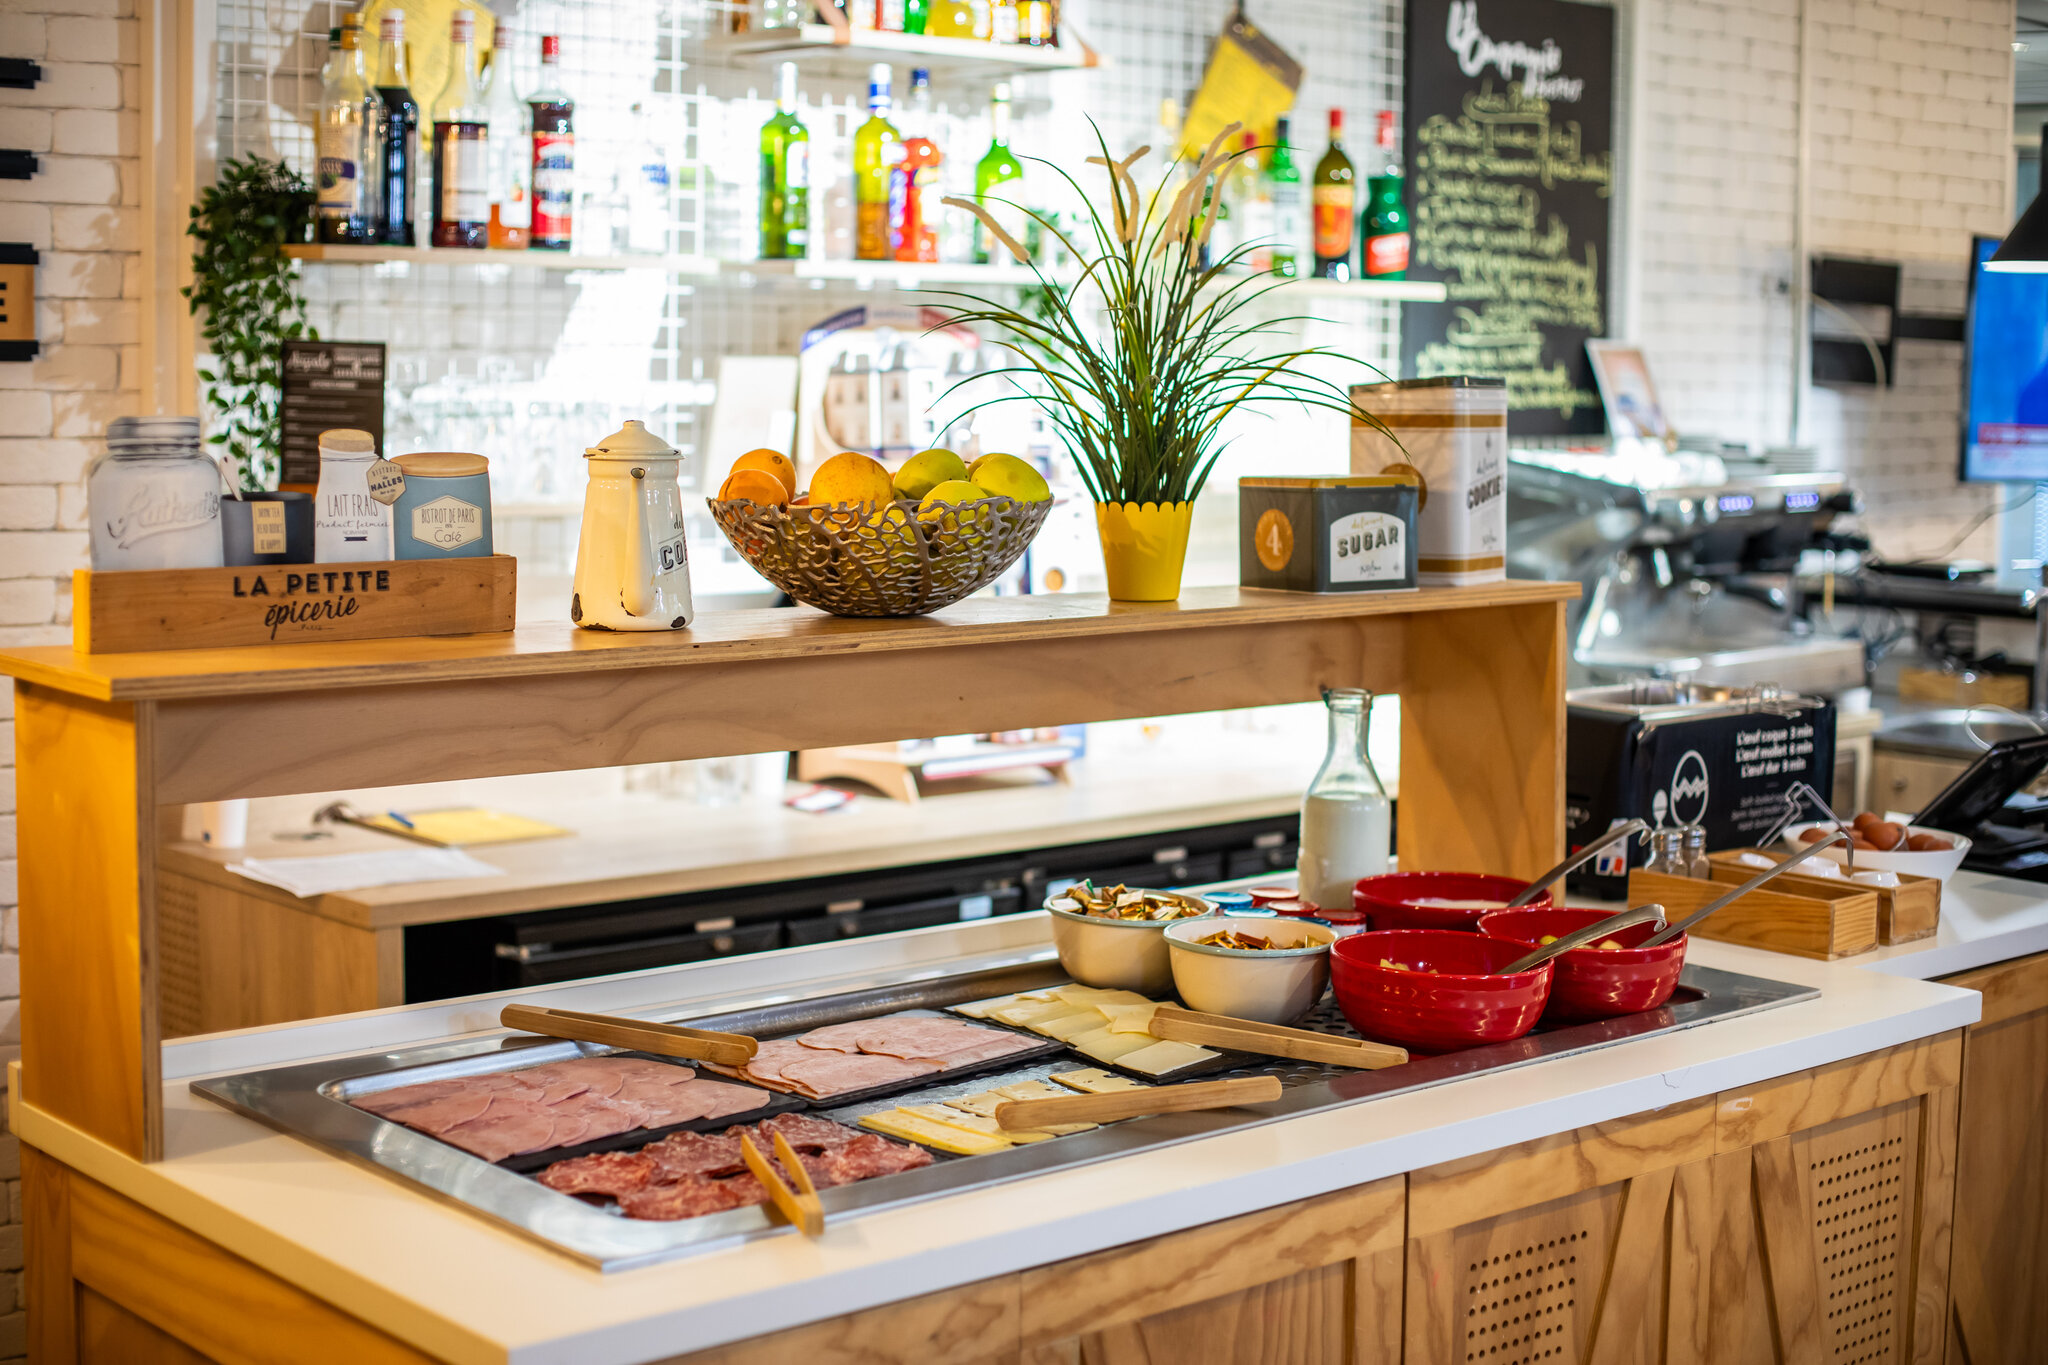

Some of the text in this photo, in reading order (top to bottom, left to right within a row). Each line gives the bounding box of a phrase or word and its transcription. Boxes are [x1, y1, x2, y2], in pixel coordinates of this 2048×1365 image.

[370, 476, 403, 492] HALLES
[327, 494, 379, 517] LAIT FRAIS
[421, 507, 475, 524] BISTROT DE PARIS
[434, 529, 462, 543] Café
[1266, 523, 1282, 556] 4
[1336, 524, 1399, 558] SUGAR
[233, 569, 390, 597] LA PETITE
[264, 595, 360, 641] épicerie
